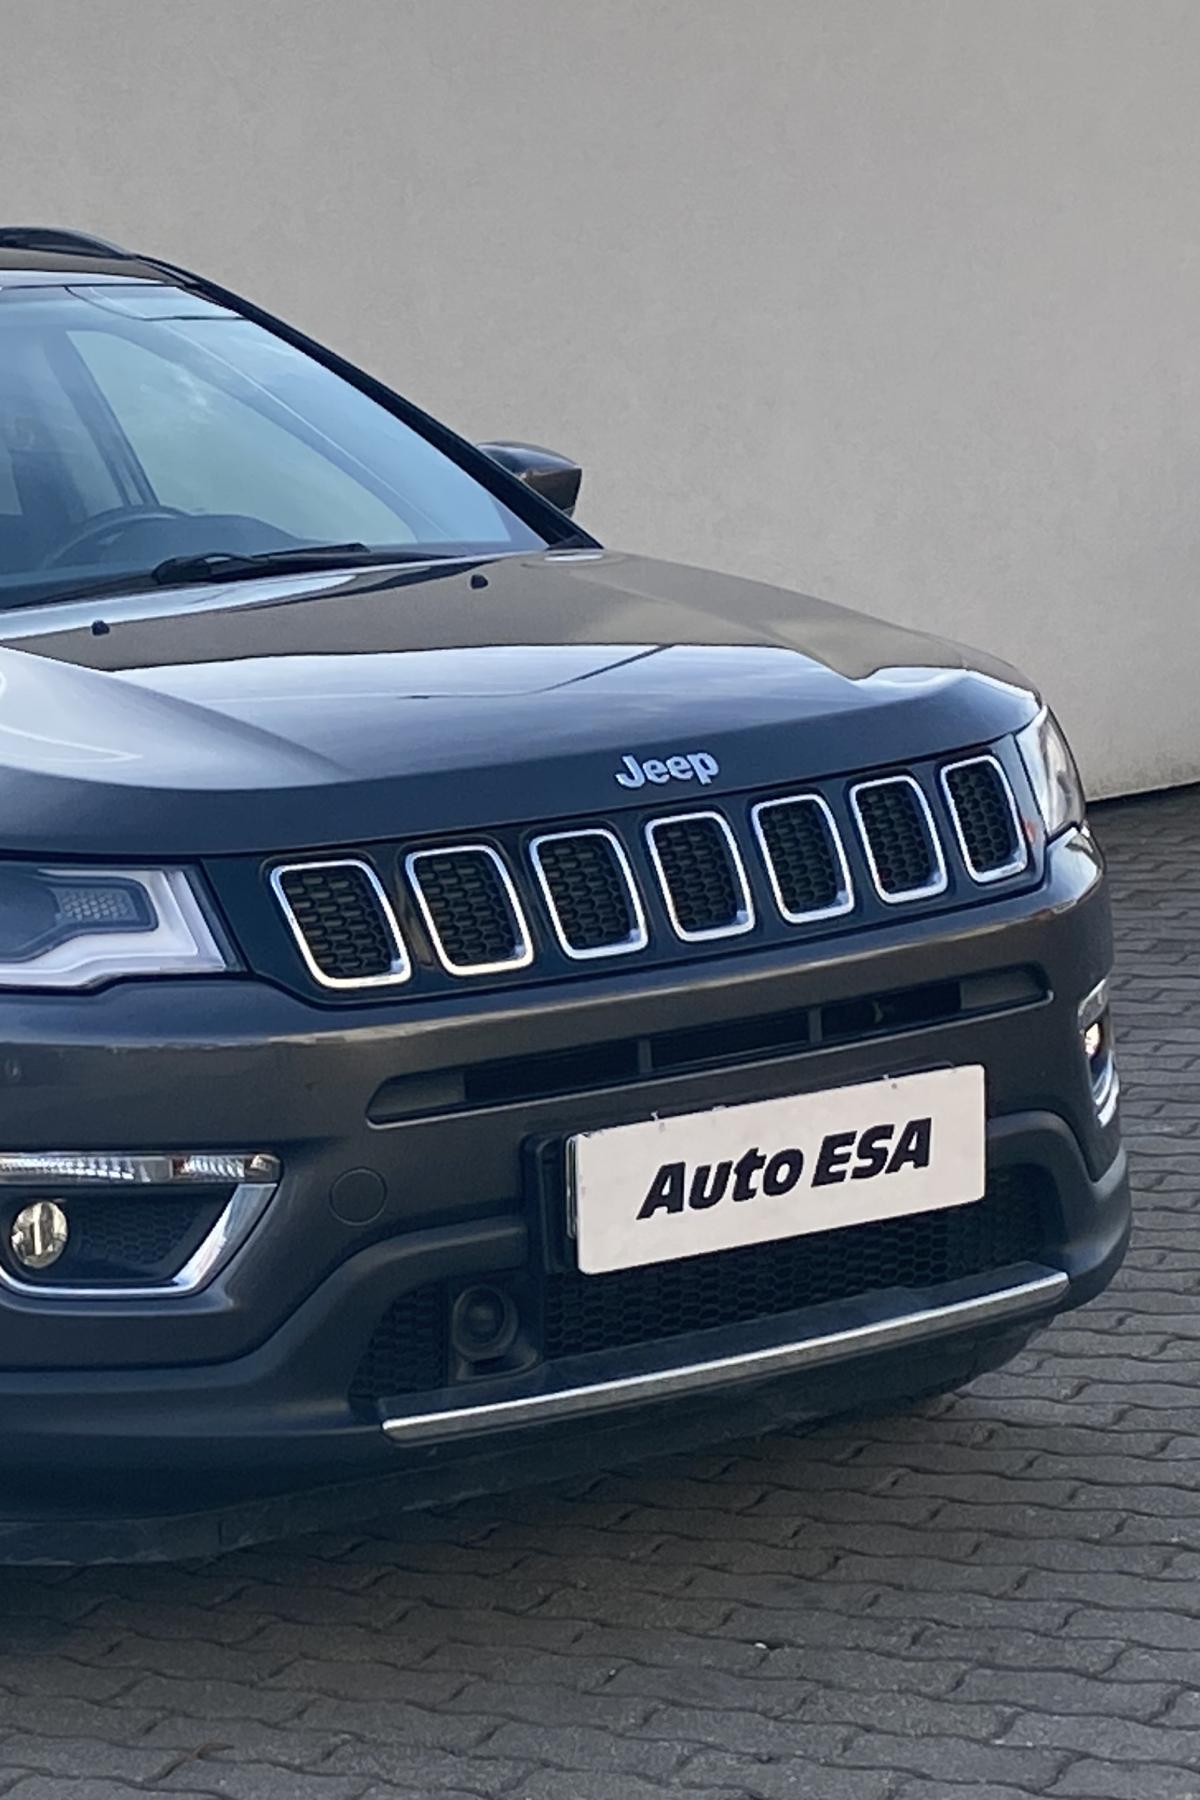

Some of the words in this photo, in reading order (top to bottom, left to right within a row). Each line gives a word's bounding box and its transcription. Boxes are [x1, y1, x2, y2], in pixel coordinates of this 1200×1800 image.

[615, 752, 719, 788] Jeep
[636, 1147, 804, 1220] Auto
[810, 1117, 932, 1188] ESA
